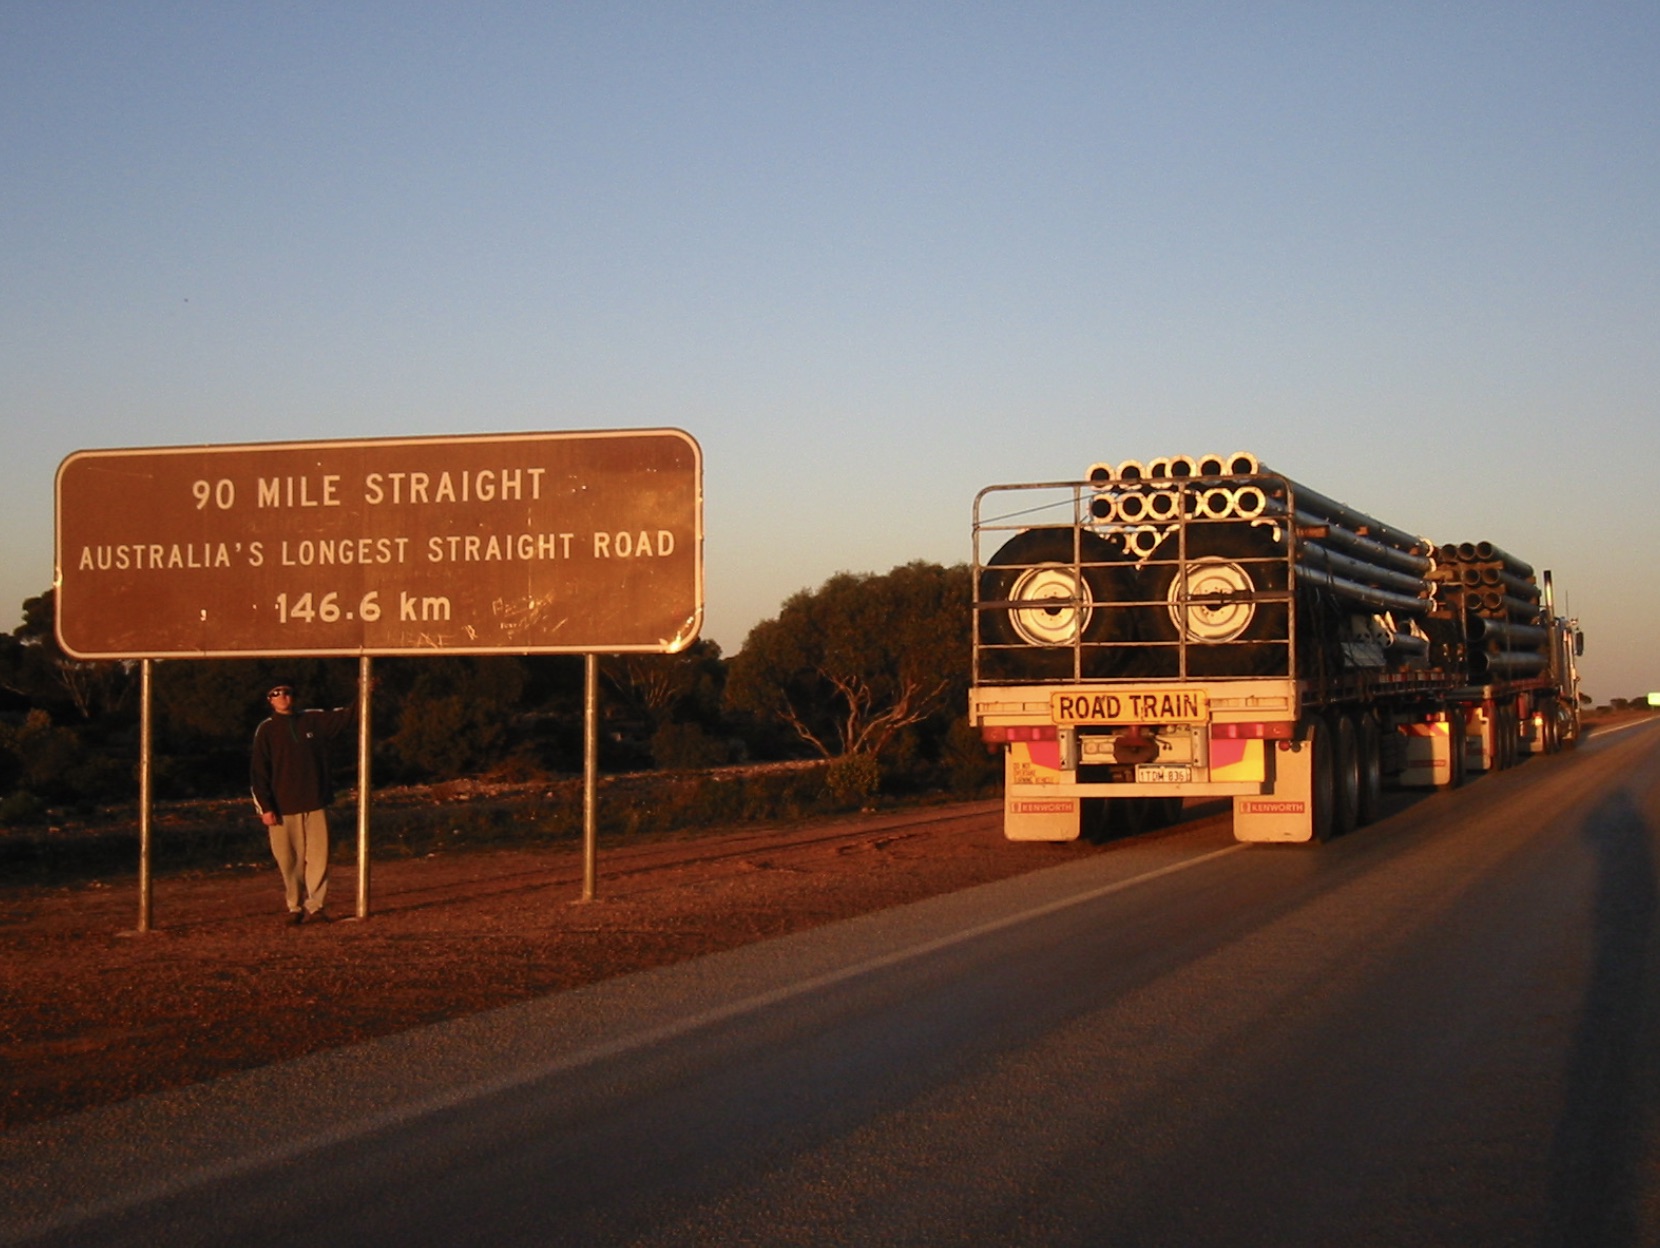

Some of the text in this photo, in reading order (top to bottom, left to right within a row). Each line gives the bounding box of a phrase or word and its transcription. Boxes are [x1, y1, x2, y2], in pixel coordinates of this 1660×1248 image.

[192, 468, 546, 510] 90 MILE STRAIGHT
[79, 530, 676, 570] AUSTRALIA'S LONGEST STRAIGHT ROAD
[276, 591, 451, 623] 146.6 km
[1059, 693, 1198, 719] ROAD TRAIN
[1022, 803, 1072, 812] KENWORTH
[1251, 803, 1304, 812] KENWORTH
